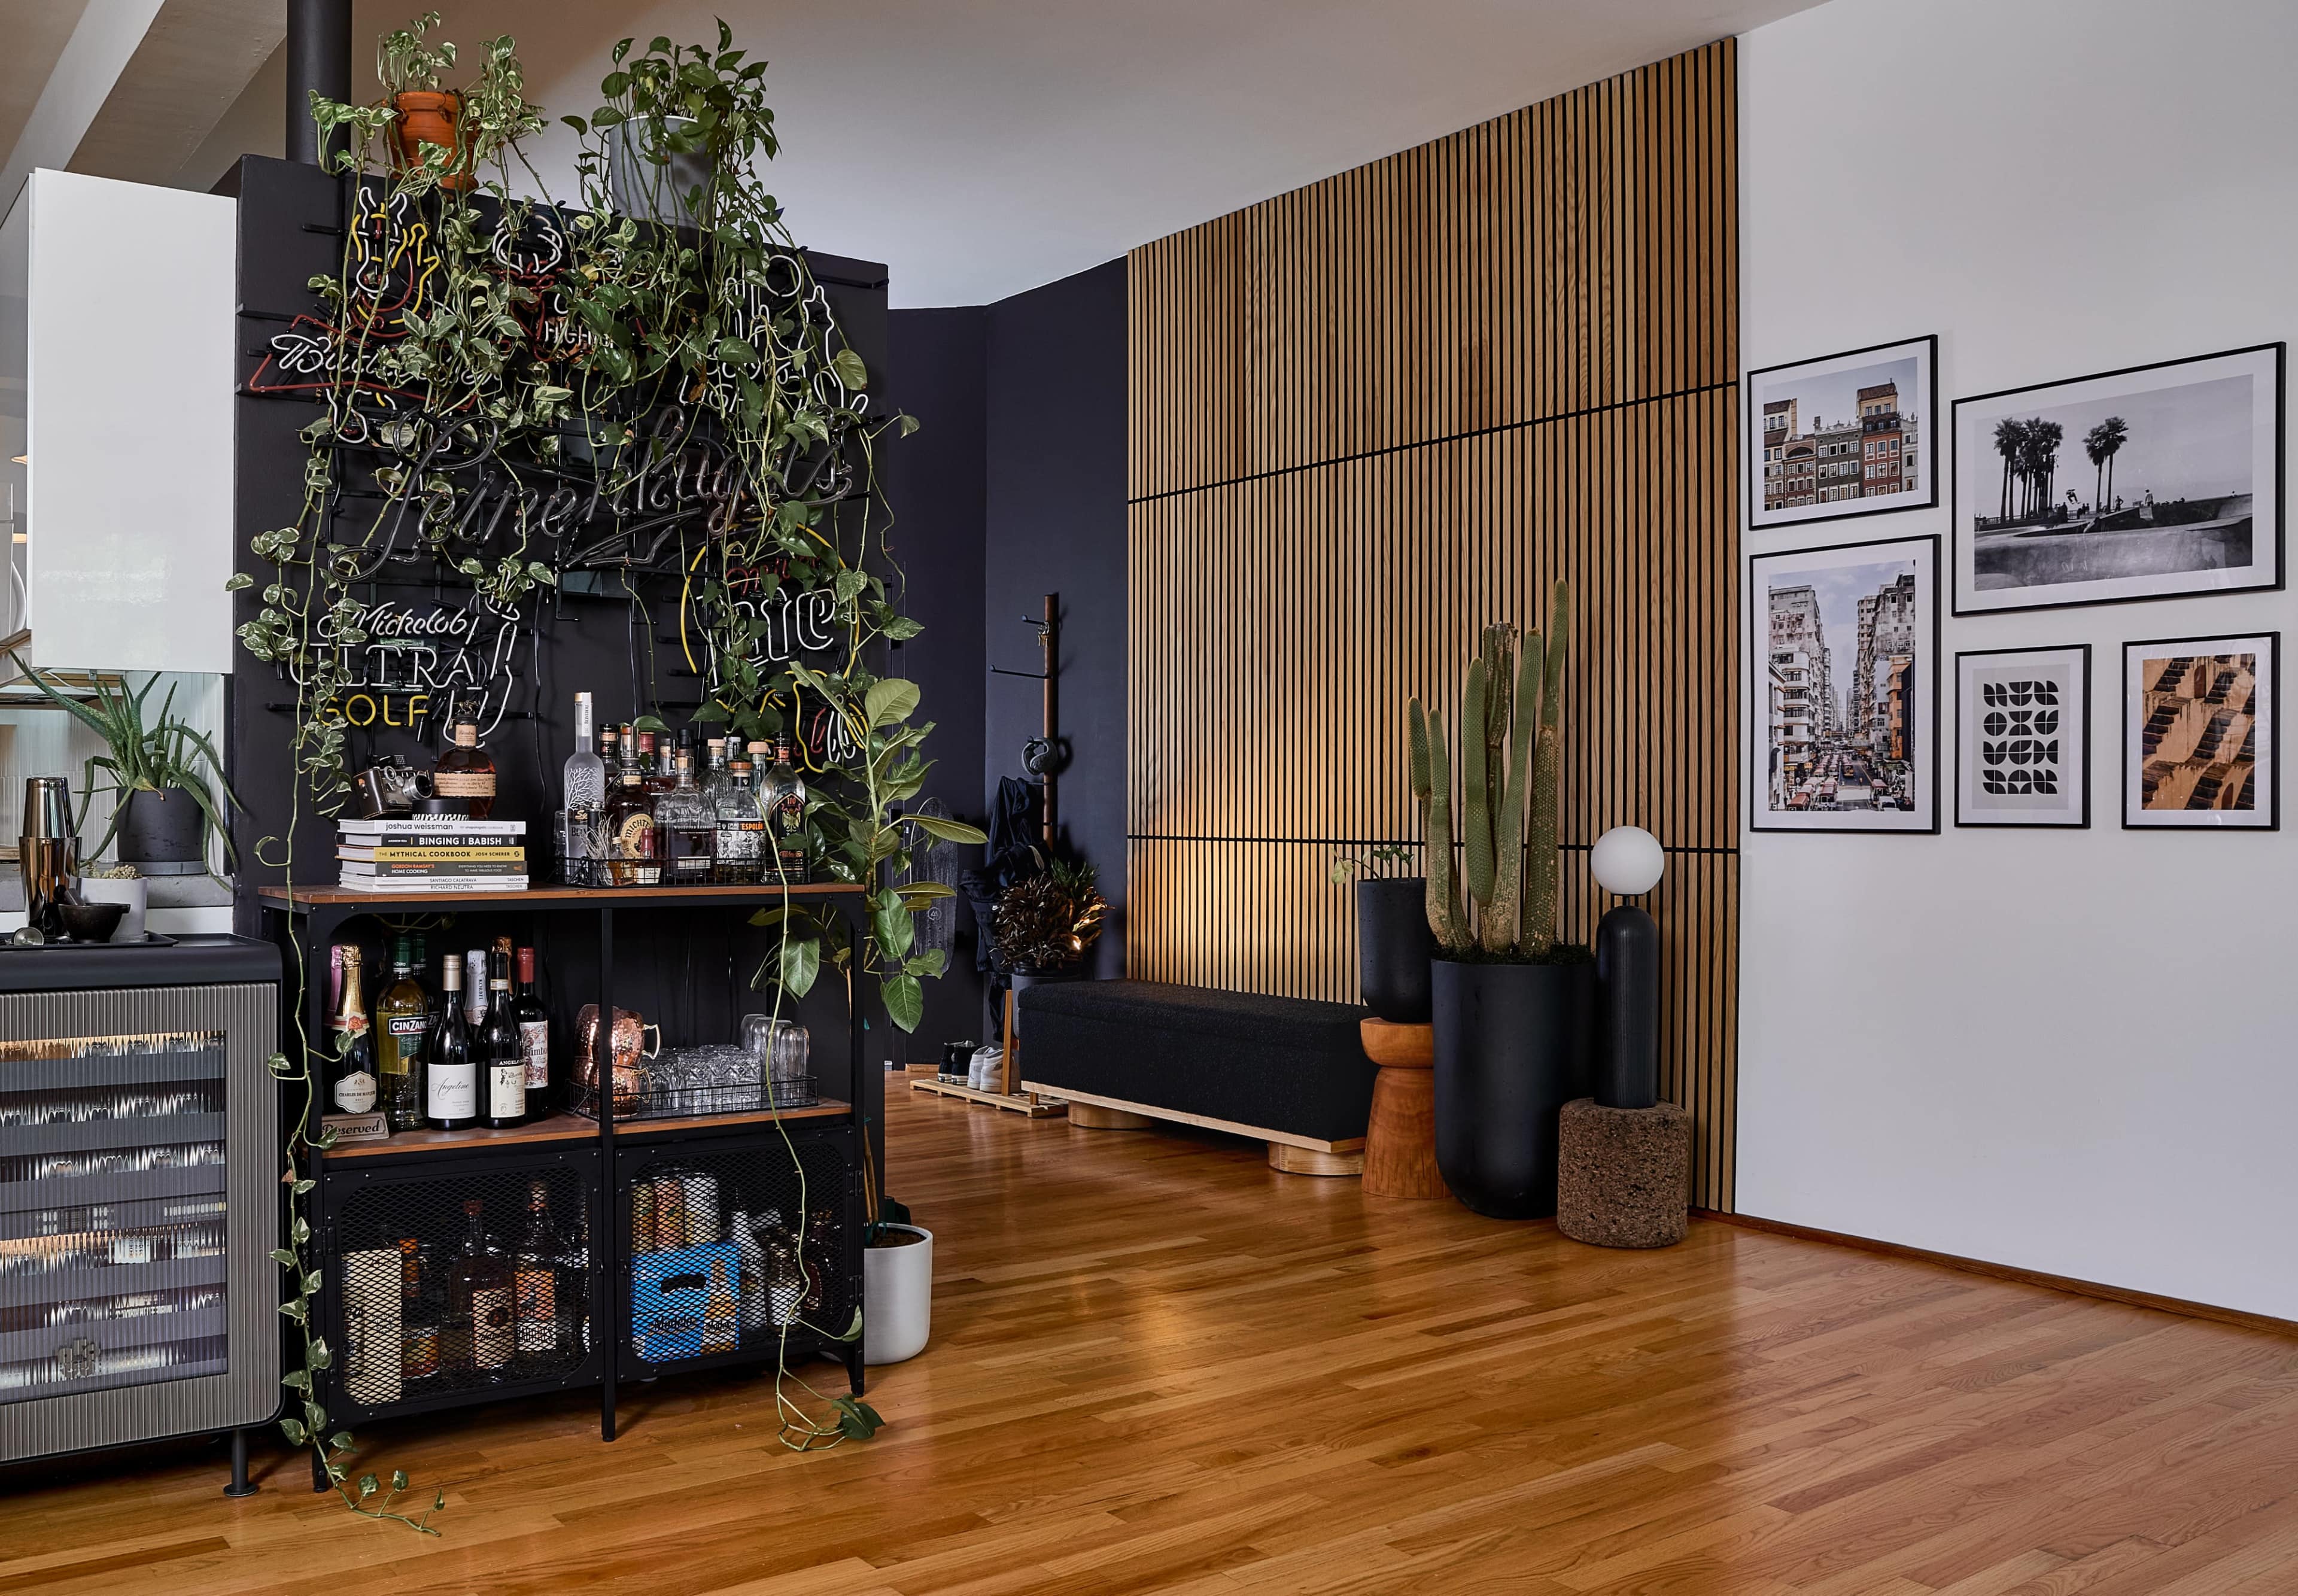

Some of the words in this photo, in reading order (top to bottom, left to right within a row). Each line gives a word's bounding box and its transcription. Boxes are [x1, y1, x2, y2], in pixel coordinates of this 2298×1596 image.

[317, 601, 468, 639] Michelob
[290, 642, 483, 690] ULTRA
[315, 694, 430, 726] GOLF
[385, 822, 412, 831] joshua
[419, 837, 460, 846] BINGING
[391, 1020, 427, 1032] CINZANO
